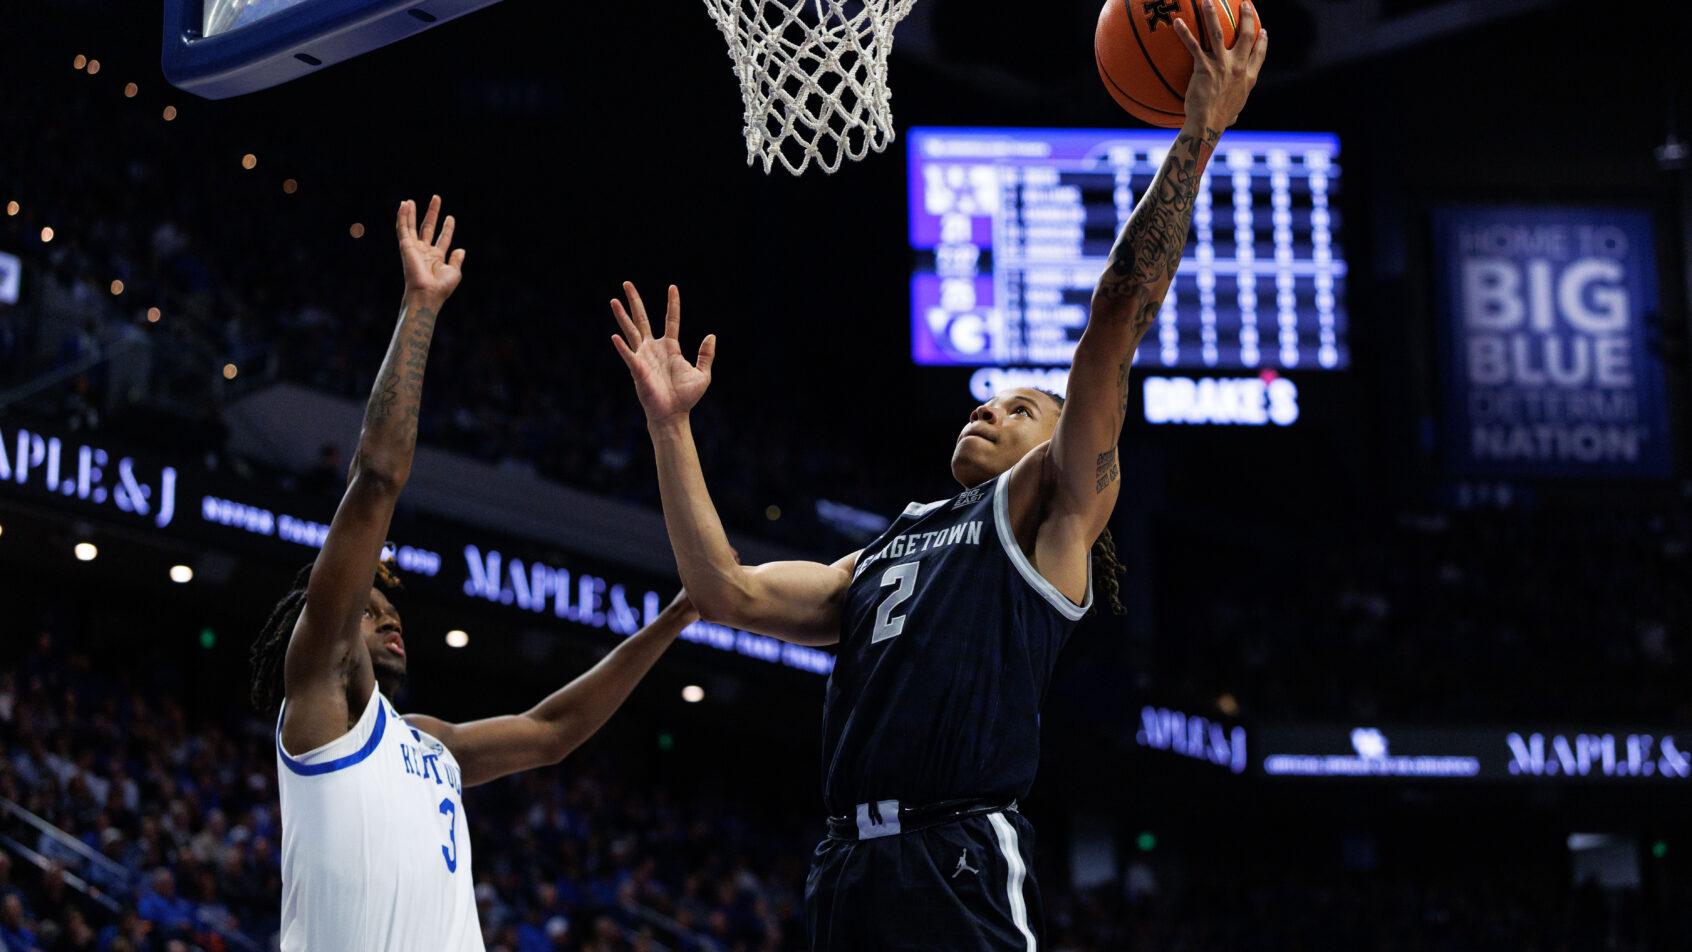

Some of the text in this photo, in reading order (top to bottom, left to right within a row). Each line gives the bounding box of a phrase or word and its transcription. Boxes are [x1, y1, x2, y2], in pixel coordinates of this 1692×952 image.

[1462, 257, 1630, 335] BIG
[1468, 334, 1633, 390] BLUE
[463, 544, 606, 627] MAPLE
[871, 561, 920, 644] 2
[1506, 732, 1656, 778] MAPLE
[439, 797, 457, 874] 3
